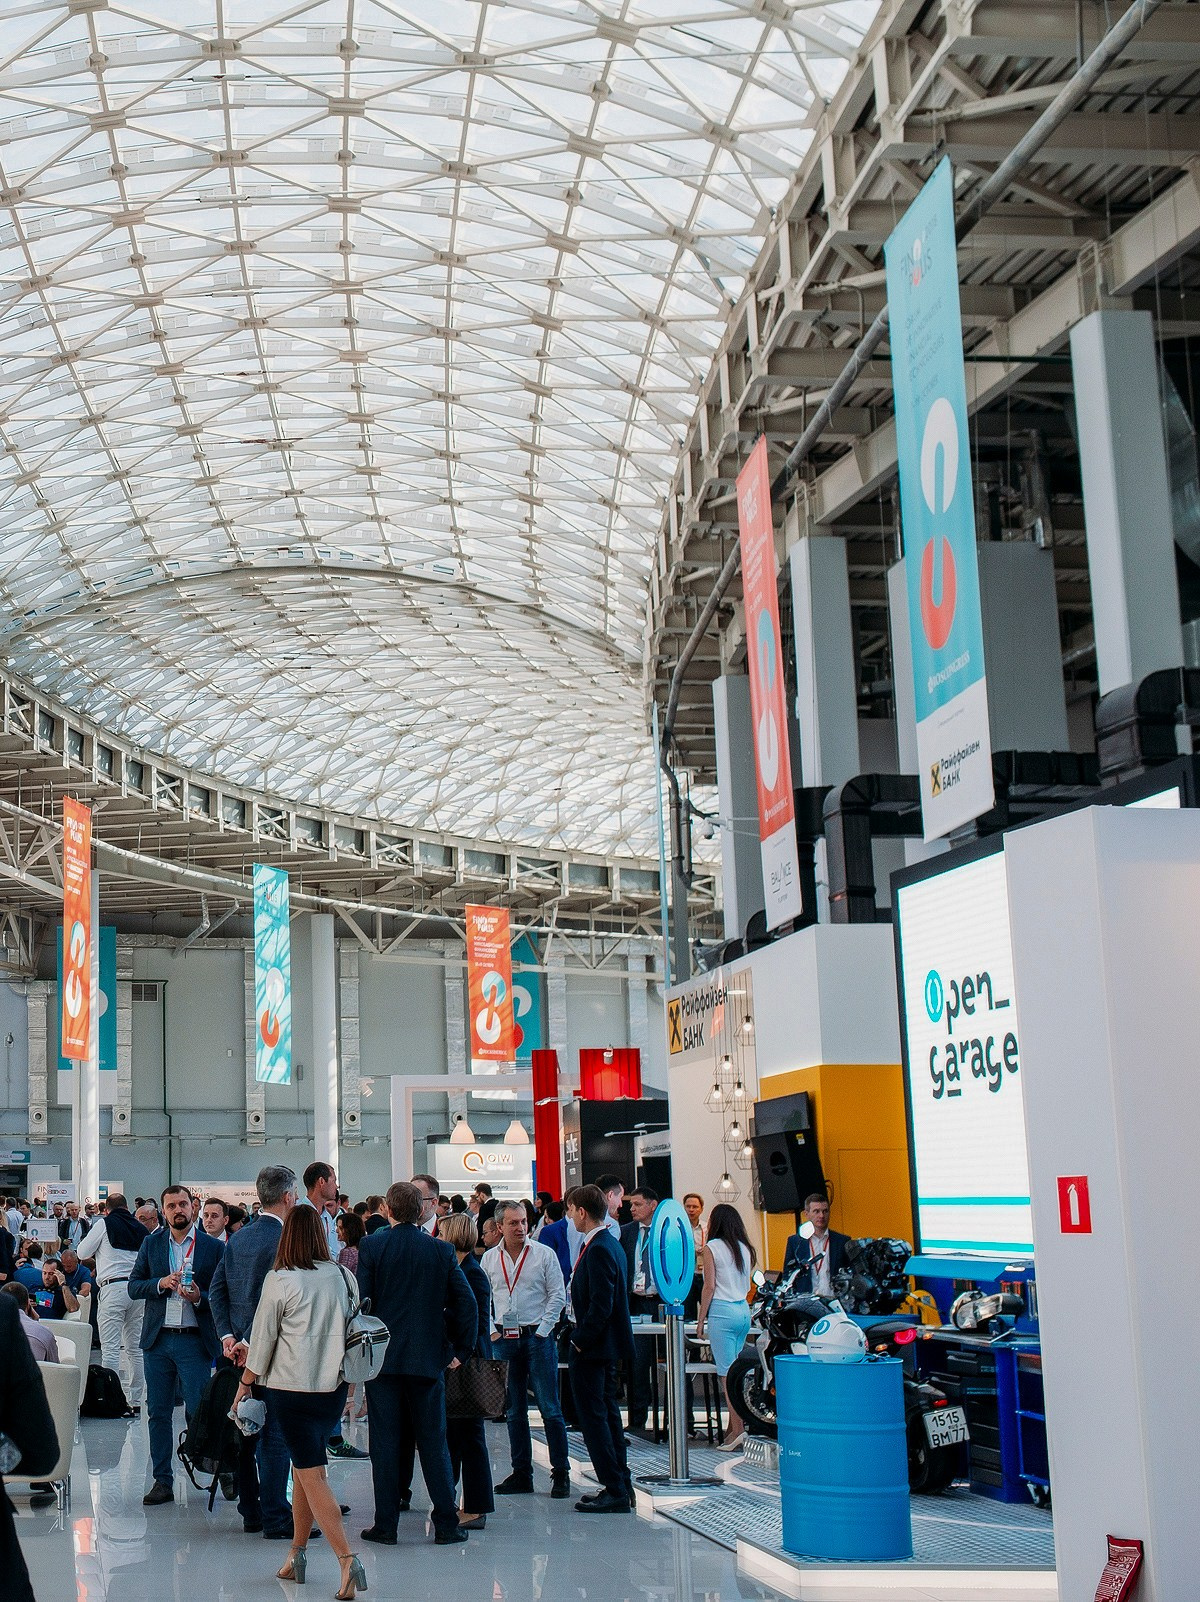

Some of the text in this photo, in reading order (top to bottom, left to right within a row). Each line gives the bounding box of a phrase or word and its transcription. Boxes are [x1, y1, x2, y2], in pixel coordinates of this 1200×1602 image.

[941, 738, 981, 773] Райффайзен
[942, 768, 961, 792] БАНК
[681, 986, 729, 1020] Райффайзен
[683, 1022, 705, 1051] БАНК
[929, 1031, 1018, 1100] garage
[931, 1410, 960, 1428] 1515
[951, 1427, 966, 1442] 77
